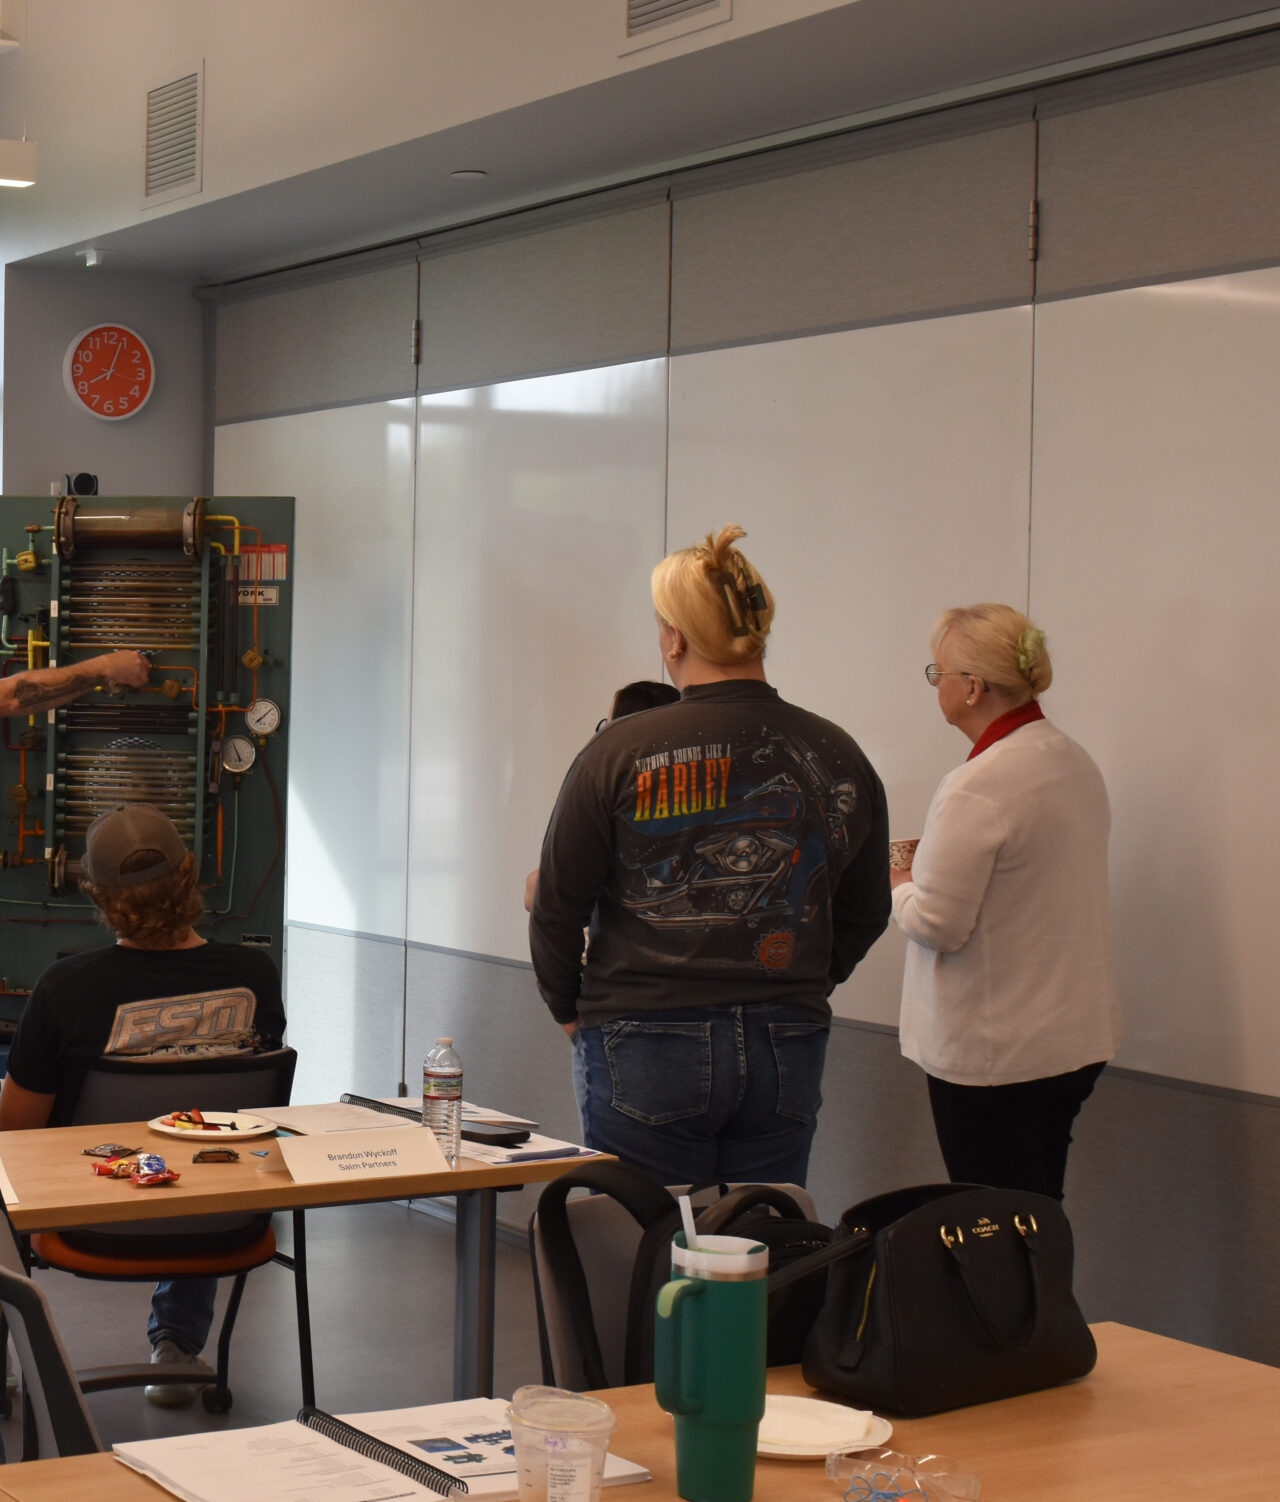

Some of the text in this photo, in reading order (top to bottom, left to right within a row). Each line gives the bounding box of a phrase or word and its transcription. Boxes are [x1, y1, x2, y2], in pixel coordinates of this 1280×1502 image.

[88, 336, 100, 349] 11
[102, 331, 118, 344] 12
[122, 336, 127, 349] 1
[77, 350, 93, 363] 10
[131, 350, 141, 363] 2
[73, 364, 83, 376] 9
[136, 368, 146, 380] 3
[78, 381, 88, 395] 8
[129, 385, 140, 398] 4
[91, 395, 100, 407] 7
[104, 401, 114, 413] 6
[119, 397, 128, 409] 5
[636, 744, 731, 773] NOTHING SOUNDS LIKE A
[633, 758, 732, 821] HARLEY
[327, 1148, 398, 1161] Brandon Wyckoff
[361, 1160, 398, 1169] Partners
[972, 1224, 1000, 1234] COACH
